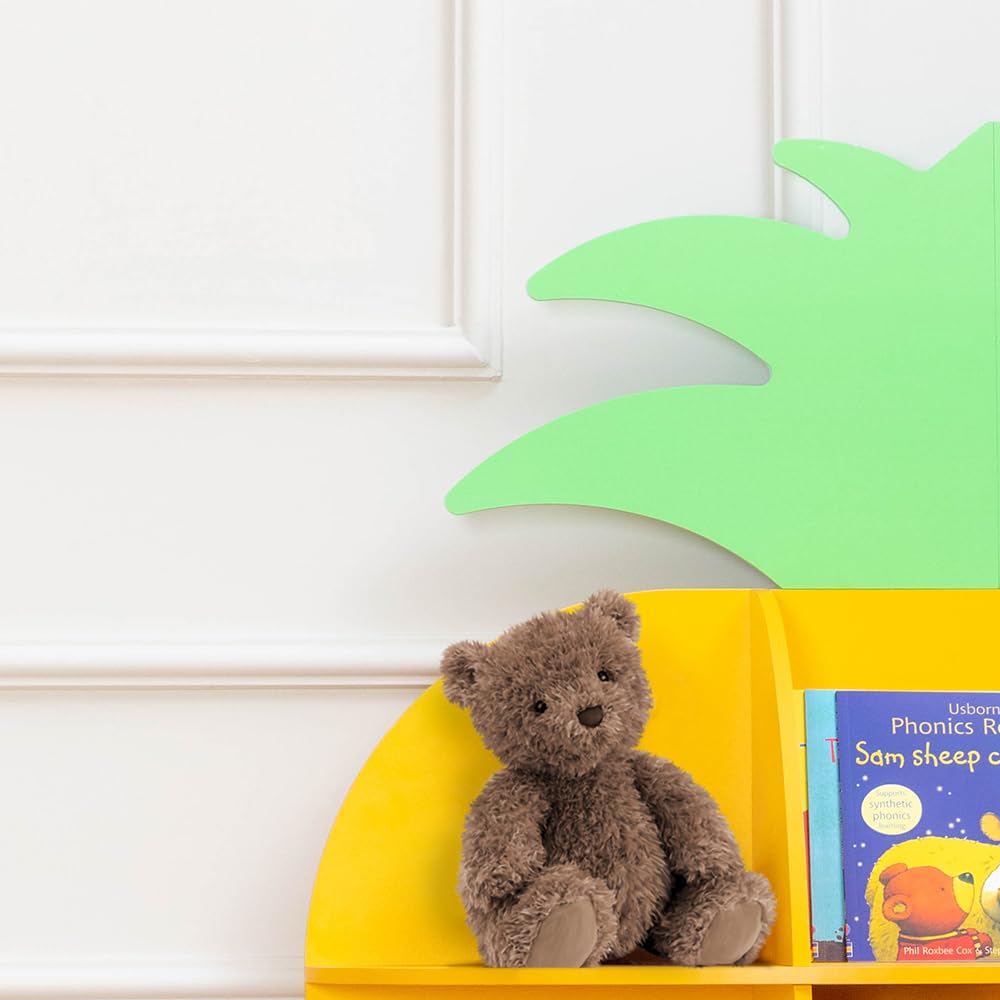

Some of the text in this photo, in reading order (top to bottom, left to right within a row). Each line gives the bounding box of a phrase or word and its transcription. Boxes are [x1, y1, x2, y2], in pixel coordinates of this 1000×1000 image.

[891, 717, 974, 735] Phonics
[855, 741, 905, 768] Sam
[912, 748, 981, 773] sheep
[869, 799, 913, 810] synthetic
[872, 811, 911, 822] phonics
[904, 946, 920, 955] Phil
[922, 946, 953, 955] Roxbee
[956, 947, 972, 955] Cox
[975, 946, 982, 955] &
